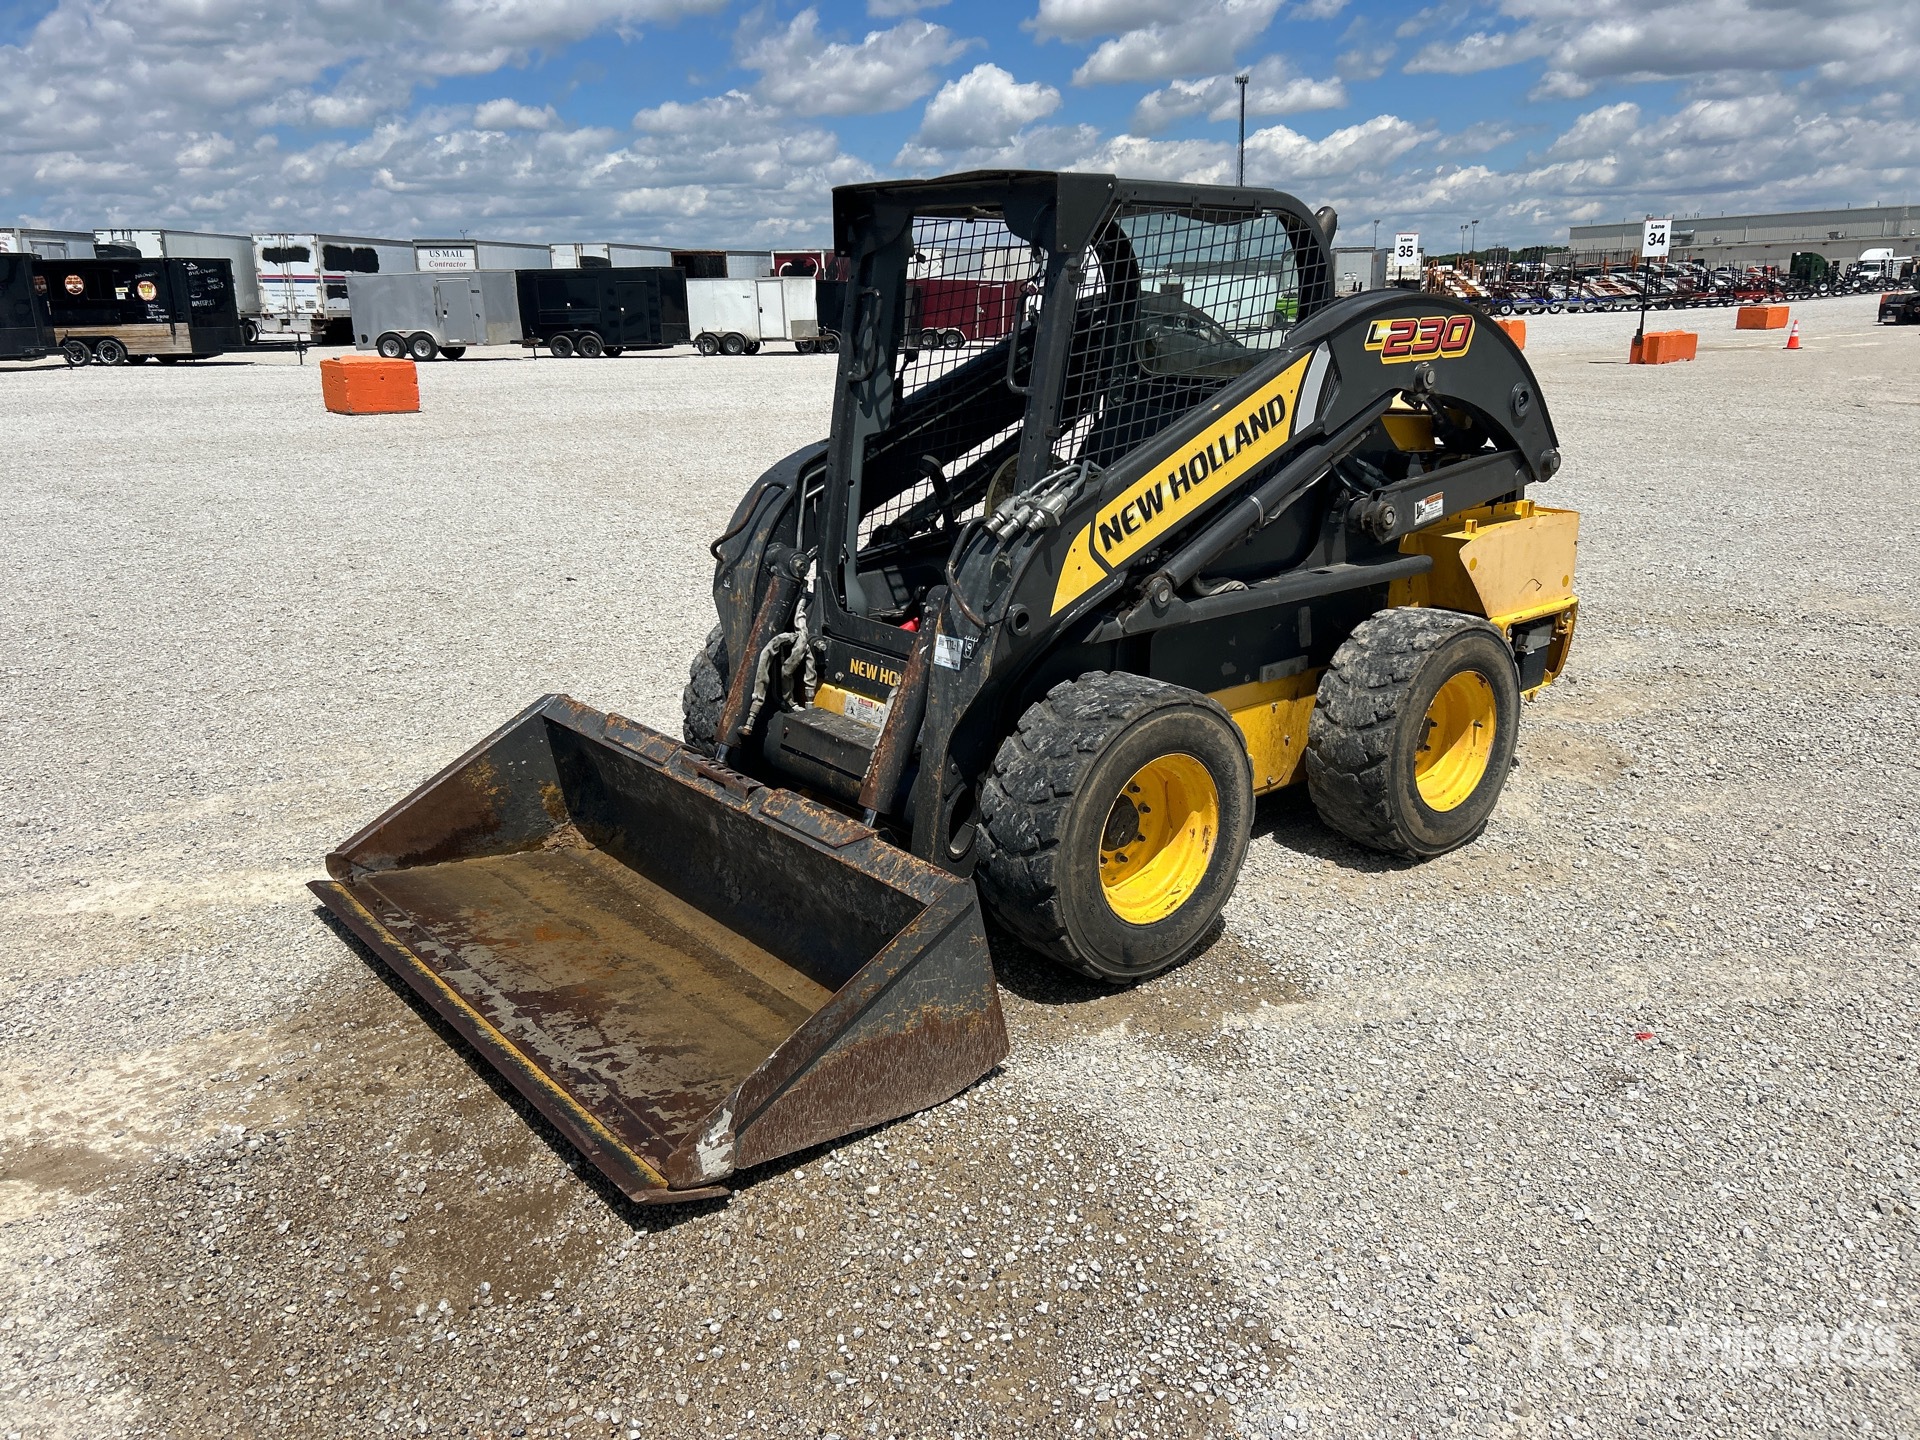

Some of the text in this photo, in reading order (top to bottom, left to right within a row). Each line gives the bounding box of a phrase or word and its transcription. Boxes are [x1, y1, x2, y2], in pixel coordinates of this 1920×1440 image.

[1648, 232, 1666, 247] 34
[429, 250, 465, 258] US MAIL
[1398, 245, 1413, 258] 35
[428, 260, 467, 268] Contractor
[1365, 315, 1474, 363] L230
[1098, 393, 1287, 553] NEW HOLLAND
[849, 657, 878, 681] NEW
